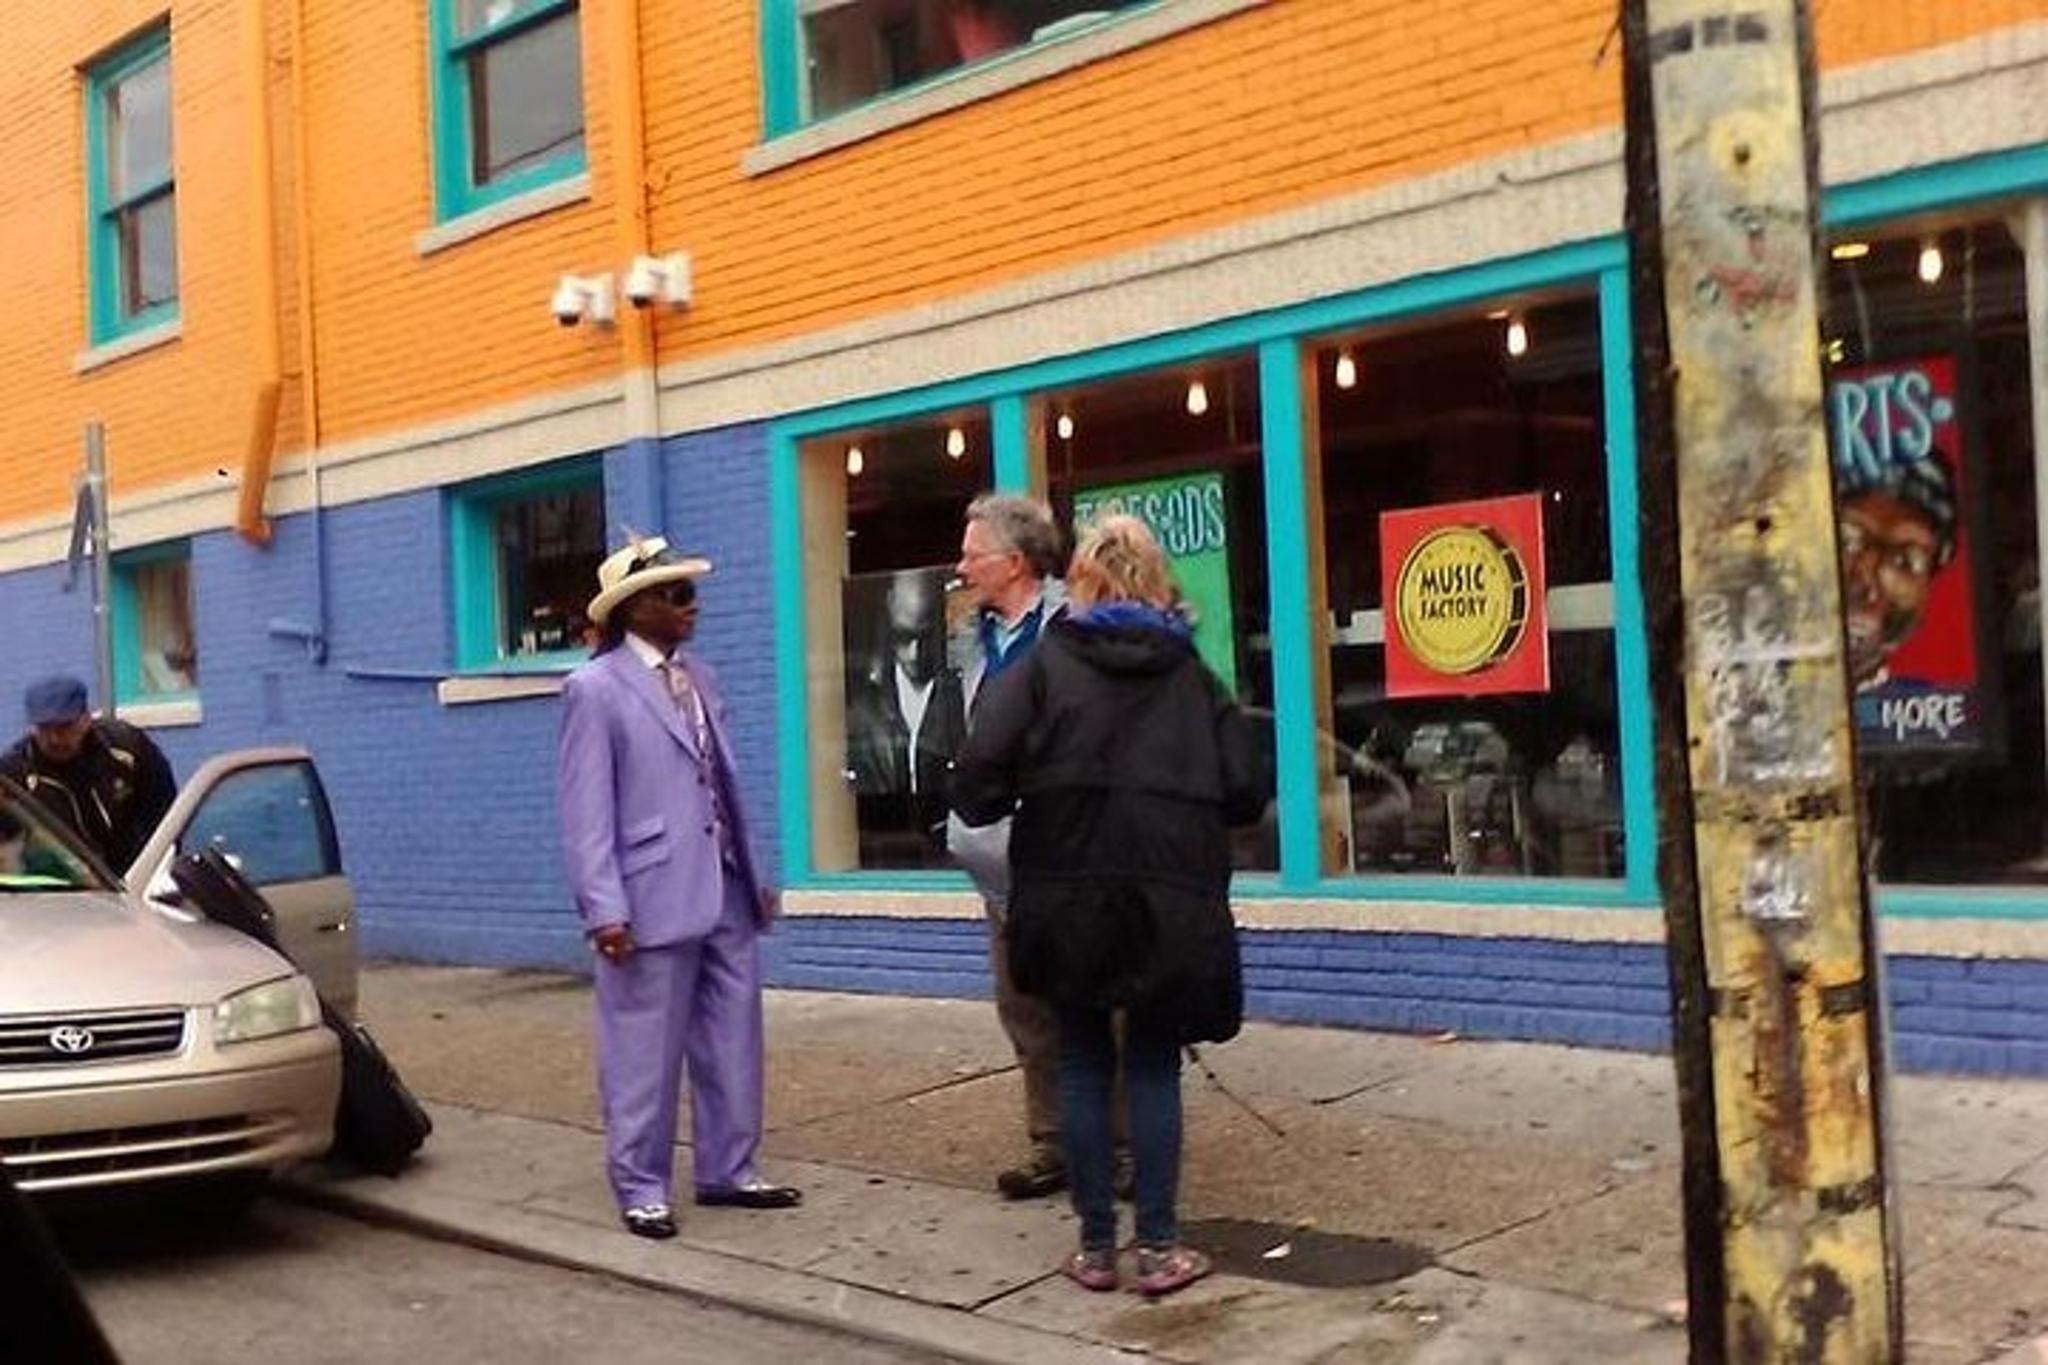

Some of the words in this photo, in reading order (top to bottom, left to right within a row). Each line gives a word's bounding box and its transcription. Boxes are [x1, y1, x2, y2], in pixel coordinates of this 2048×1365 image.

[1419, 563, 1485, 596] MUSIC
[1420, 597, 1486, 620] FACTORY
[1882, 694, 1966, 742] MORE
